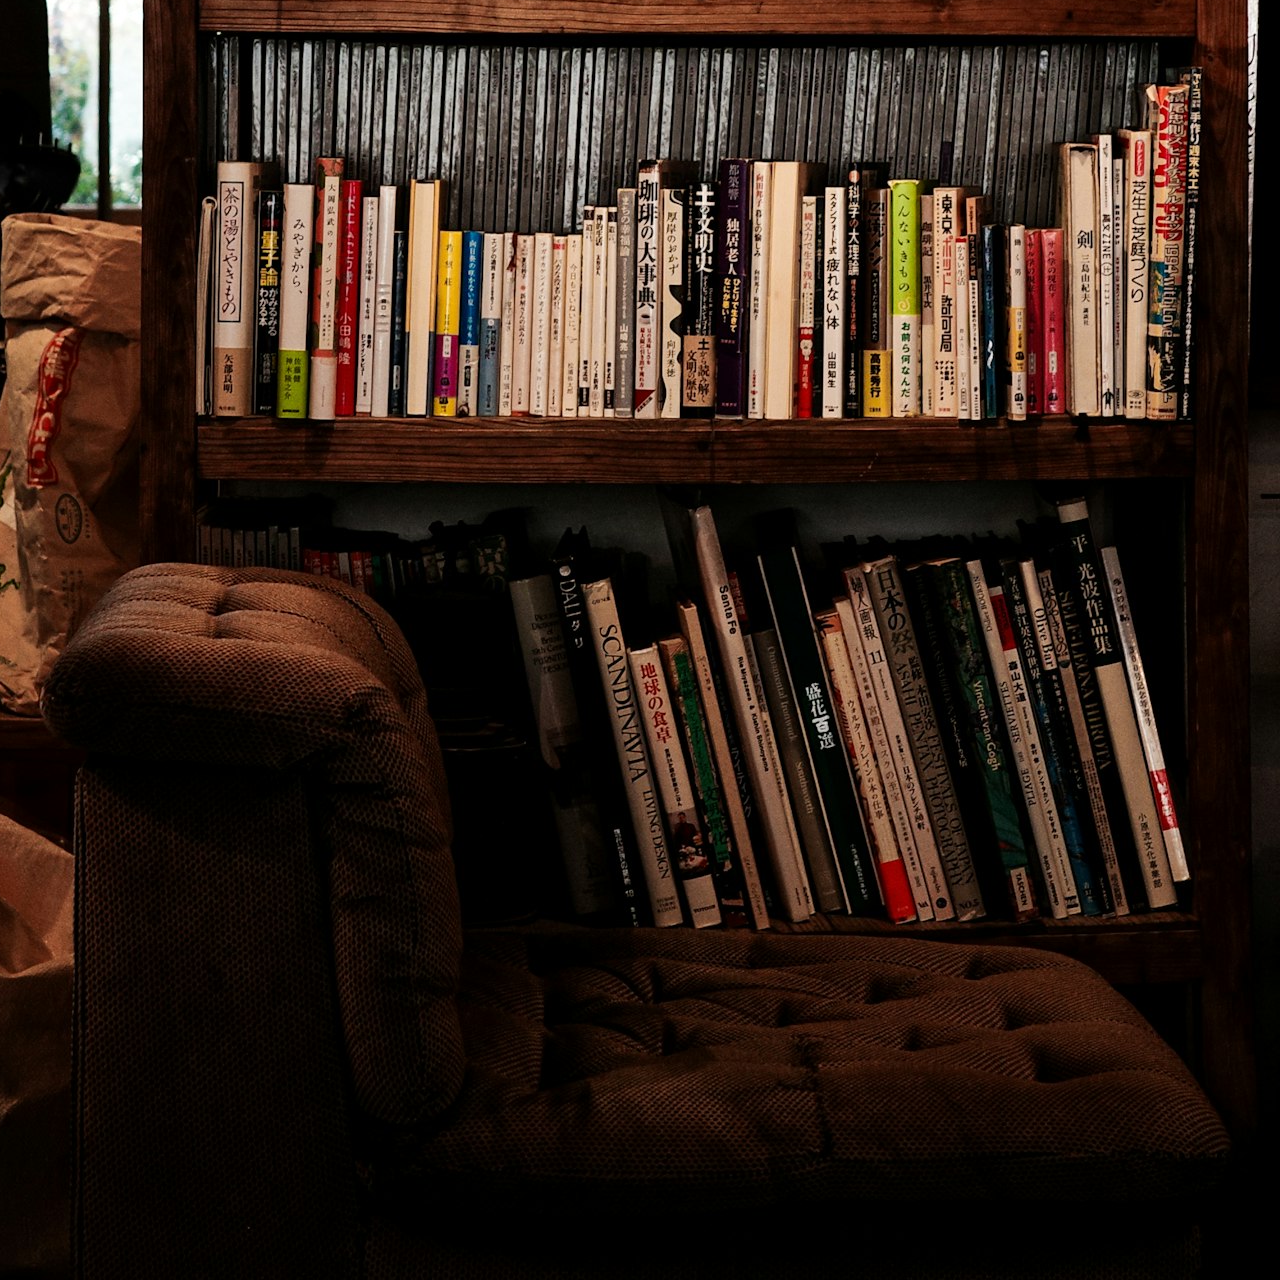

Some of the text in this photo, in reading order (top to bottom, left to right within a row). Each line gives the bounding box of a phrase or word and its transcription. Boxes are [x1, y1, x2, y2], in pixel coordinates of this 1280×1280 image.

[222, 186, 241, 316] 茶の湯とやきもの
[291, 218, 307, 295] みやぎから、
[637, 178, 659, 310] 珈琲の大事典
[665, 211, 679, 277] 厚岸のおかず
[694, 184, 715, 274] 土の文明史
[725, 163, 741, 277] 都築響一 独居老人
[847, 184, 861, 277] 科学の大理論
[897, 192, 911, 293] へんないきもの
[1076, 228, 1093, 250] 剣
[1130, 180, 1147, 304] 芝生と芝庭づくり
[260, 229, 280, 288] 量子論
[825, 192, 841, 331] スタンフォード式 疲れない体
[939, 193, 954, 354] 東京ポッド許可局
[956, 244, 966, 287] かるい生活
[1080, 252, 1092, 303] 三島由紀夫
[258, 287, 269, 327] わかる本
[268, 287, 279, 337] がみるみる
[337, 311, 353, 366] 小田嶋隆
[223, 353, 235, 395] 矢部良明
[293, 356, 302, 384] 佐藤健
[826, 351, 837, 388] 山田知生
[869, 352, 882, 398] 高野秀行
[900, 321, 912, 399] お前ら何なんだ
[558, 576, 582, 623] DALI
[720, 584, 738, 636] Santa Fe
[849, 576, 878, 641] 婦人画報
[877, 570, 915, 655] 日本の祭
[1071, 533, 1113, 656] 平 光波作品集
[868, 650, 886, 666] 11
[1033, 607, 1054, 670] Olive Bar
[639, 663, 673, 744] 地球の食卓
[804, 681, 838, 751] 盛花百選
[973, 679, 1001, 773] Vincent van Gogh
[598, 623, 671, 880] SCANDINAVIA LIVING DESIGN
[895, 662, 965, 889] ASAHI PHOTOGRAPHY
[1000, 681, 1037, 807] SERVIETTES PLIAGE
[926, 734, 977, 887] FESTIVALS OF JAPAN
[1014, 874, 1029, 908] TASCHEN
